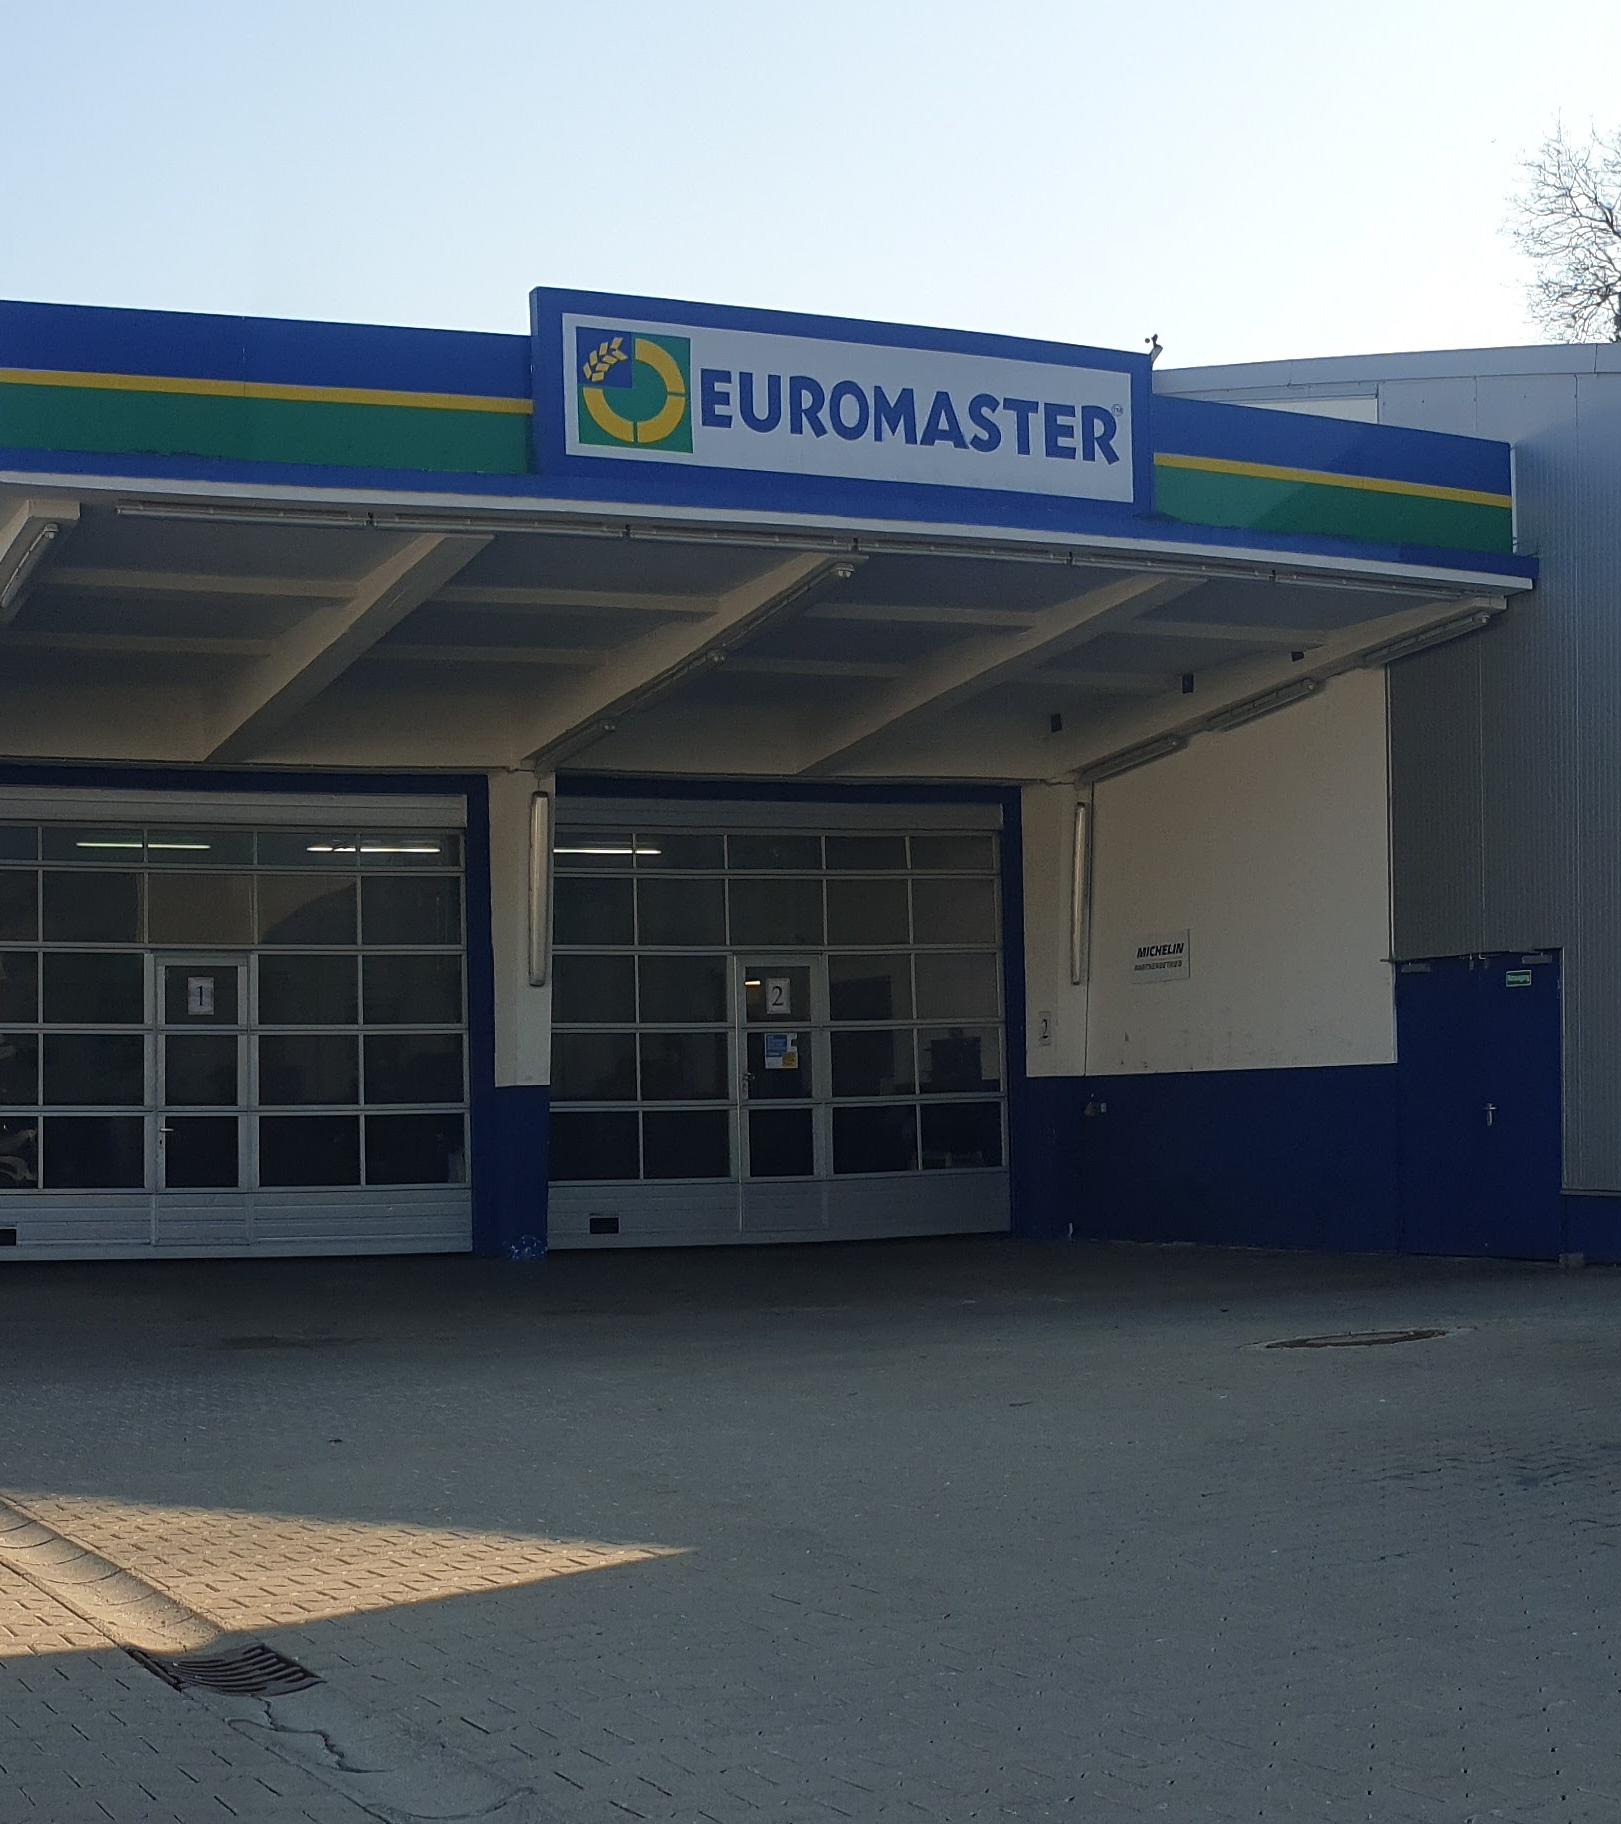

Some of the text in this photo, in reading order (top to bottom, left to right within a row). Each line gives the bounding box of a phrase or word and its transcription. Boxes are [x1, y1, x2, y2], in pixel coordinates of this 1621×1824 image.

[701, 368, 1120, 465] EUROMASTER
[1137, 943, 1184, 959] MICHELIN
[772, 986, 784, 1006] 2
